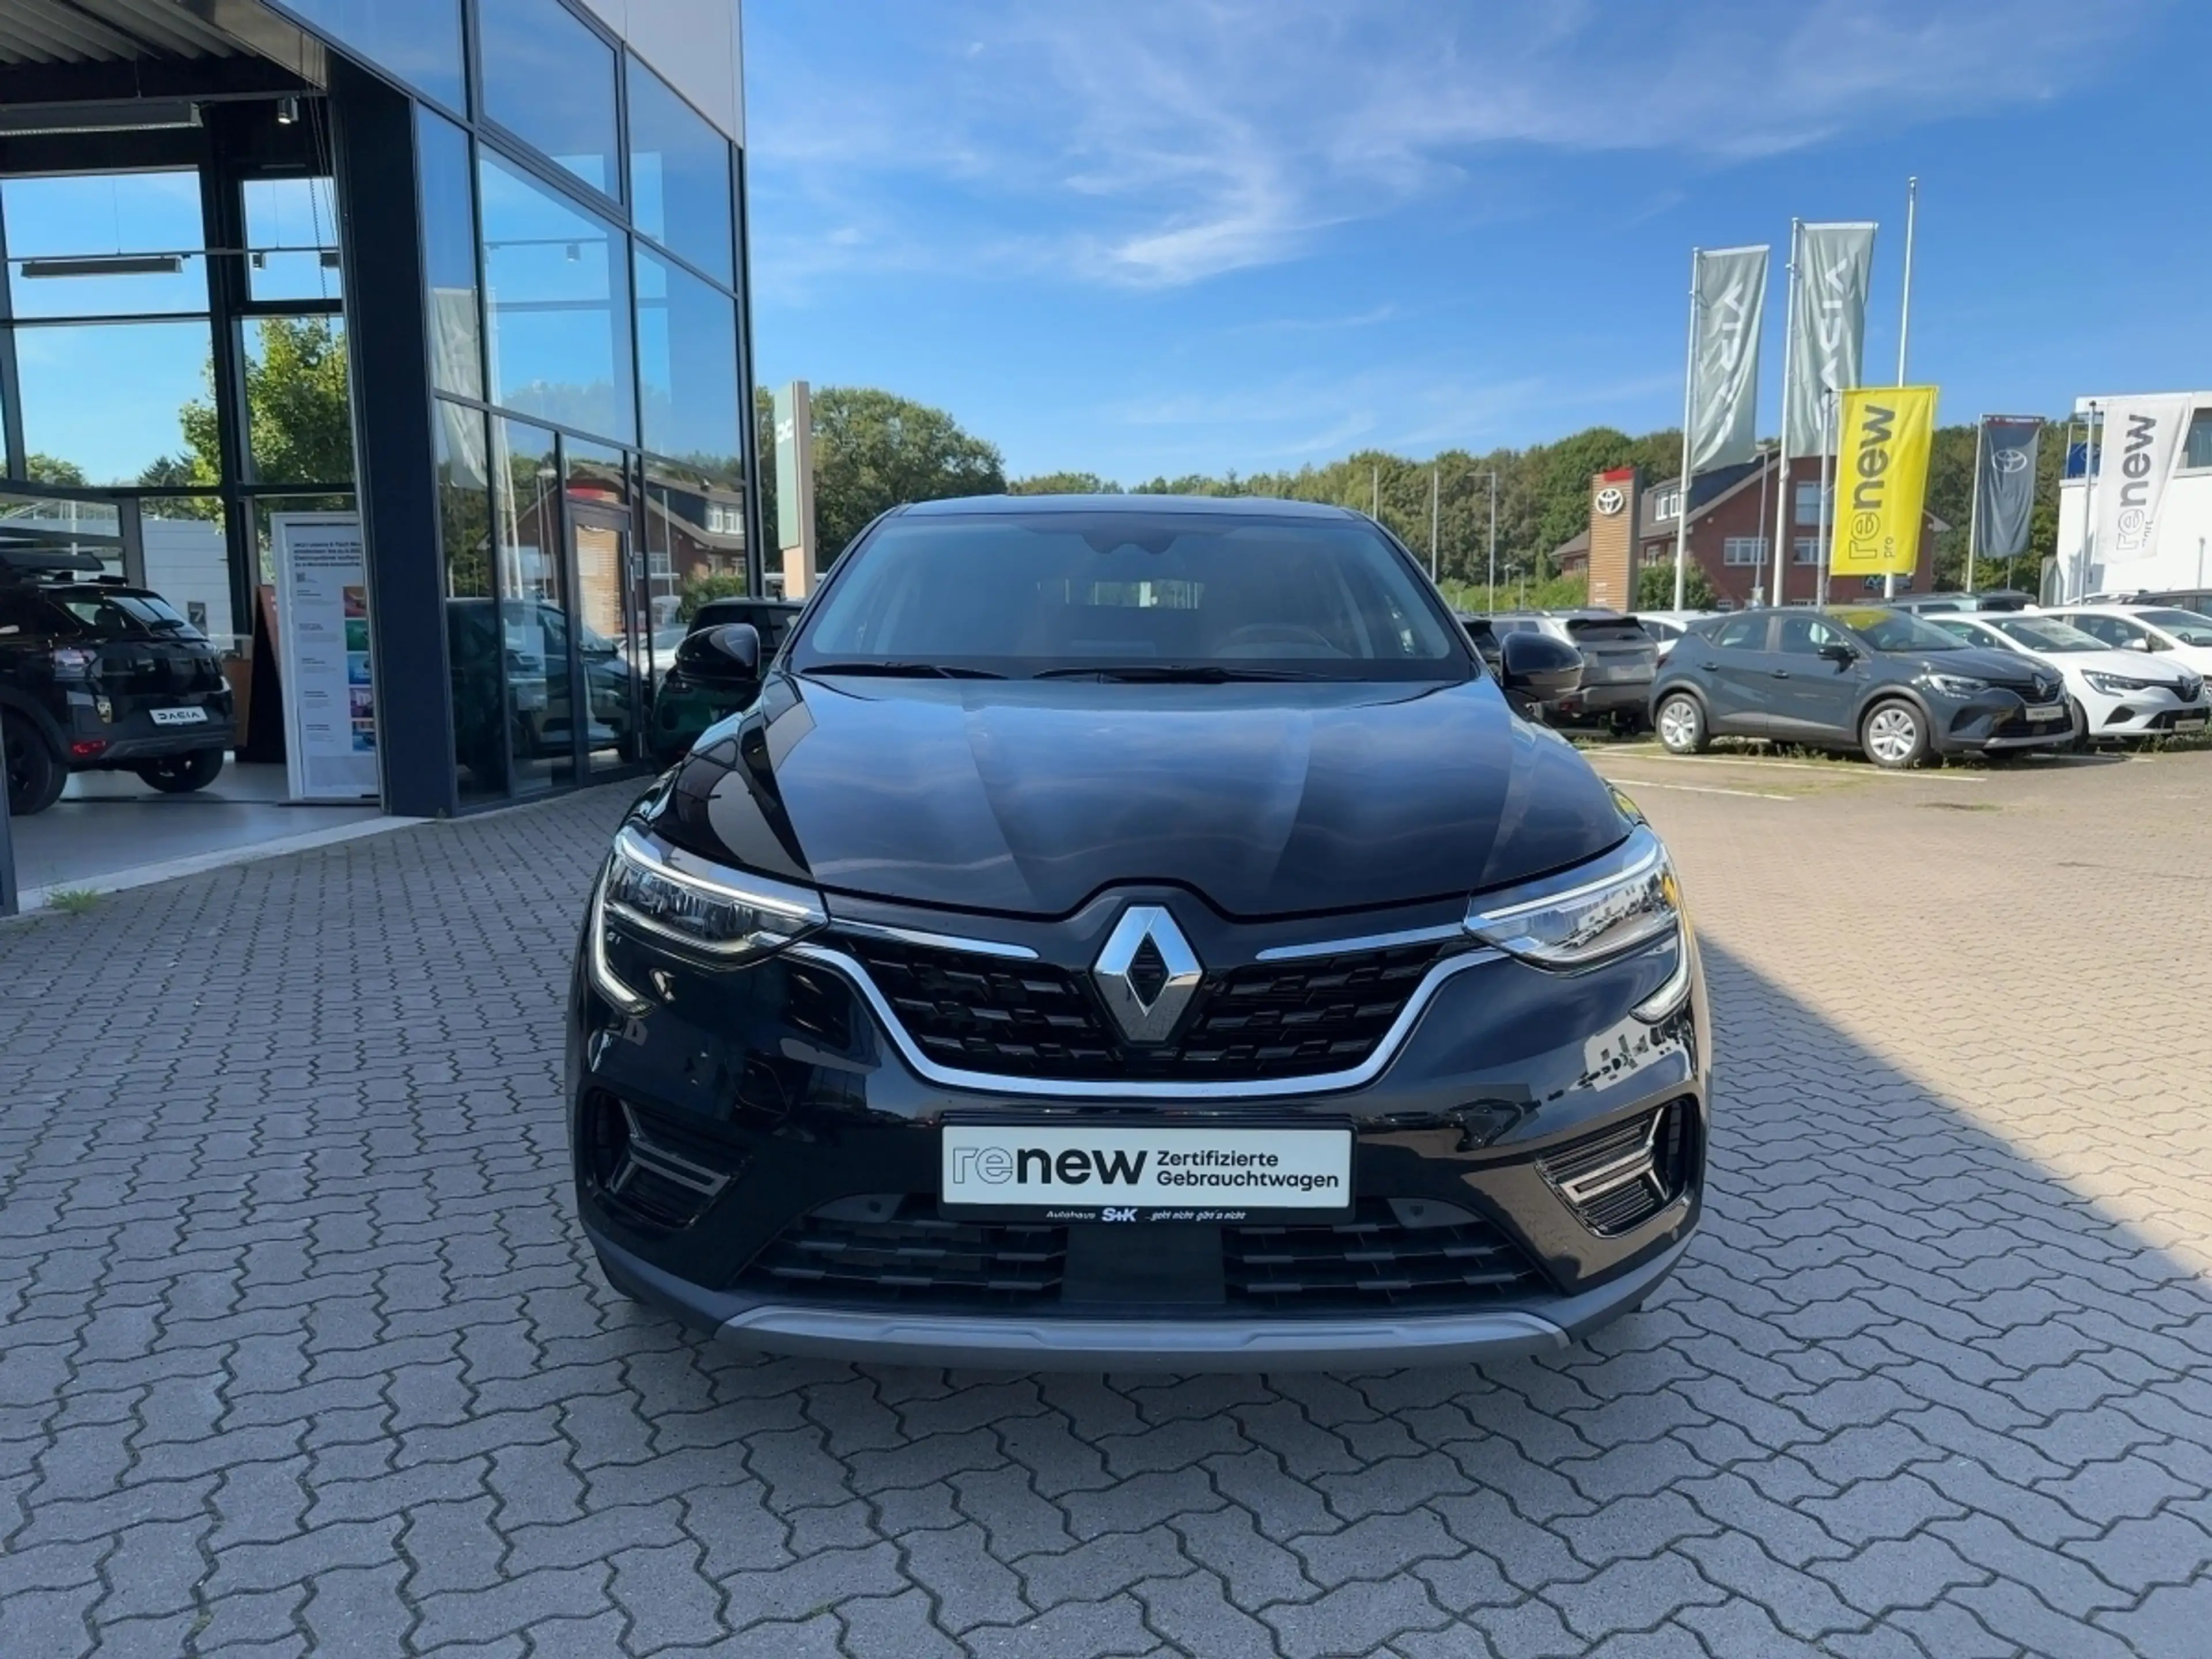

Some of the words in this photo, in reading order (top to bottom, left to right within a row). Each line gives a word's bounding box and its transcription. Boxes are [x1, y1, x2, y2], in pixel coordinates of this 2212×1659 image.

[1849, 404, 1896, 560] renew
[2116, 413, 2157, 551] renew
[1884, 535, 1895, 559] pro
[190, 608, 203, 622] 7
[157, 711, 200, 720] DACIA
[952, 1145, 1147, 1185] renew
[1157, 1150, 1279, 1167] Zertifizierte
[1157, 1169, 1339, 1191] Gebrauchtwagen
[1046, 1210, 1096, 1219] Autohaus
[1101, 1207, 1138, 1222] S+K
